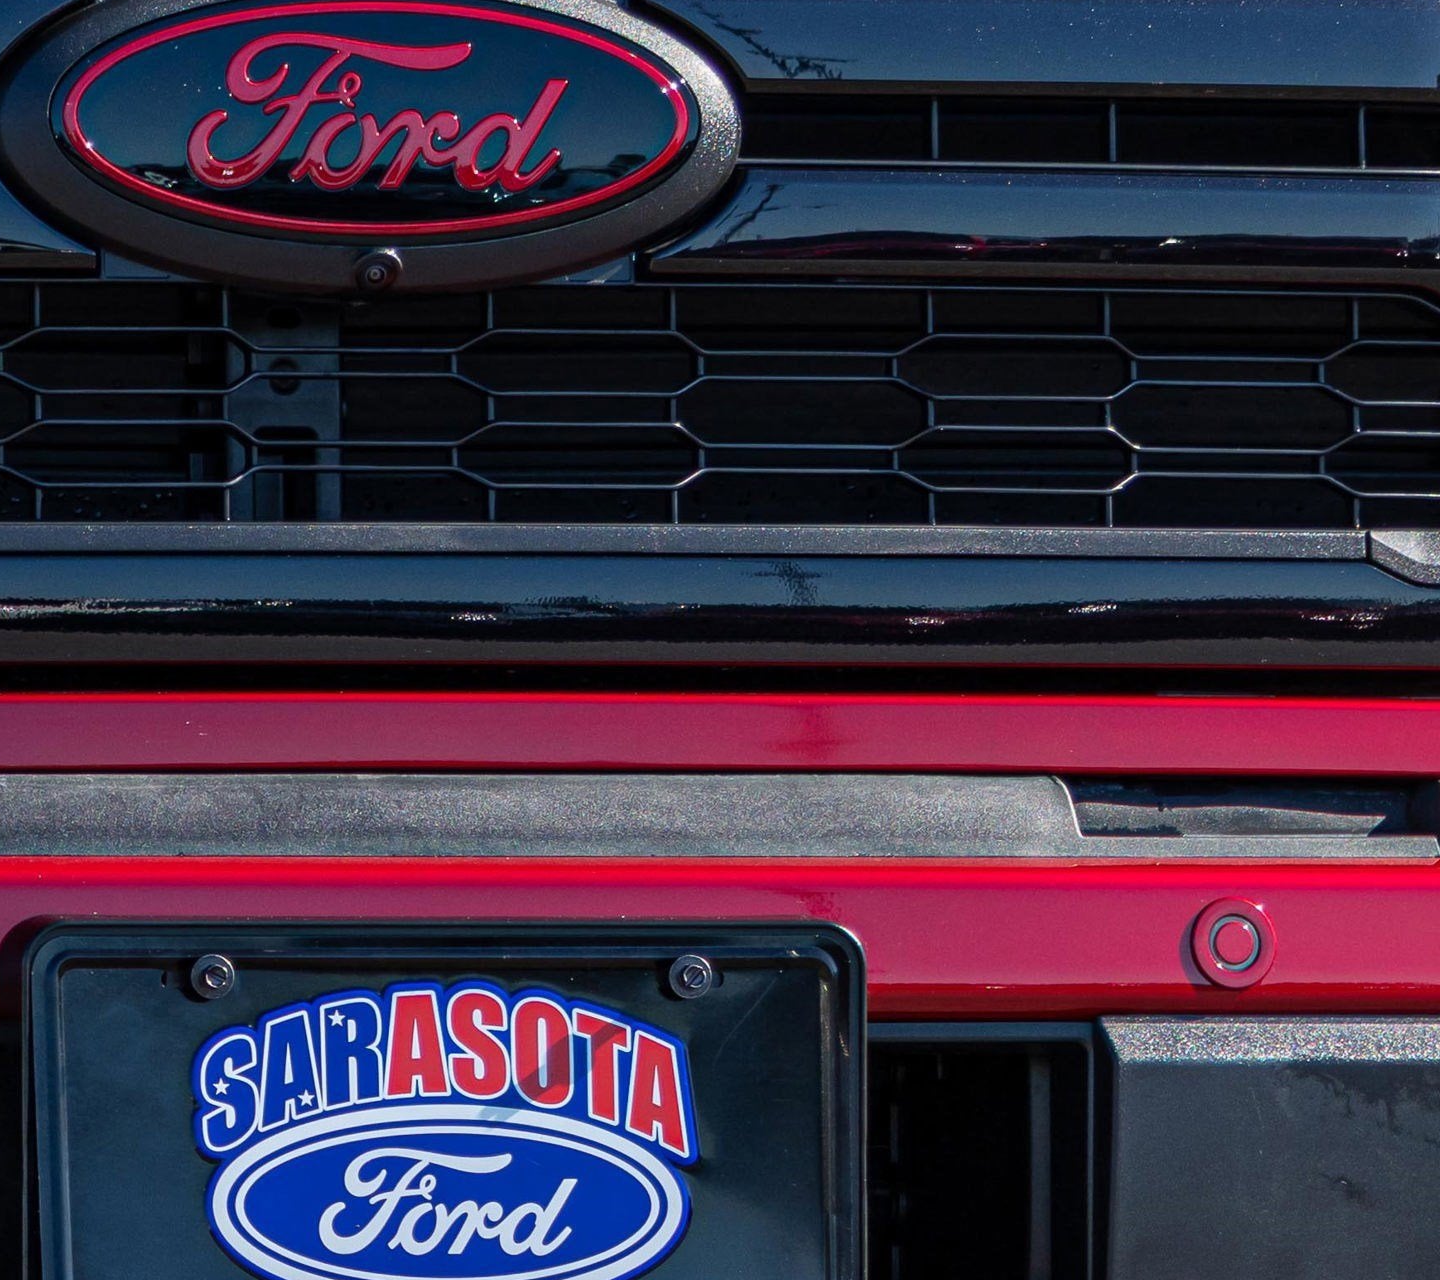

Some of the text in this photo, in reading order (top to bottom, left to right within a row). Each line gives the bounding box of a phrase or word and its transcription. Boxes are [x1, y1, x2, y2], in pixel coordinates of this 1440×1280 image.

[186, 32, 569, 192] Ford
[200, 989, 691, 1158] SARASOTA
[319, 1147, 578, 1256] Ford
